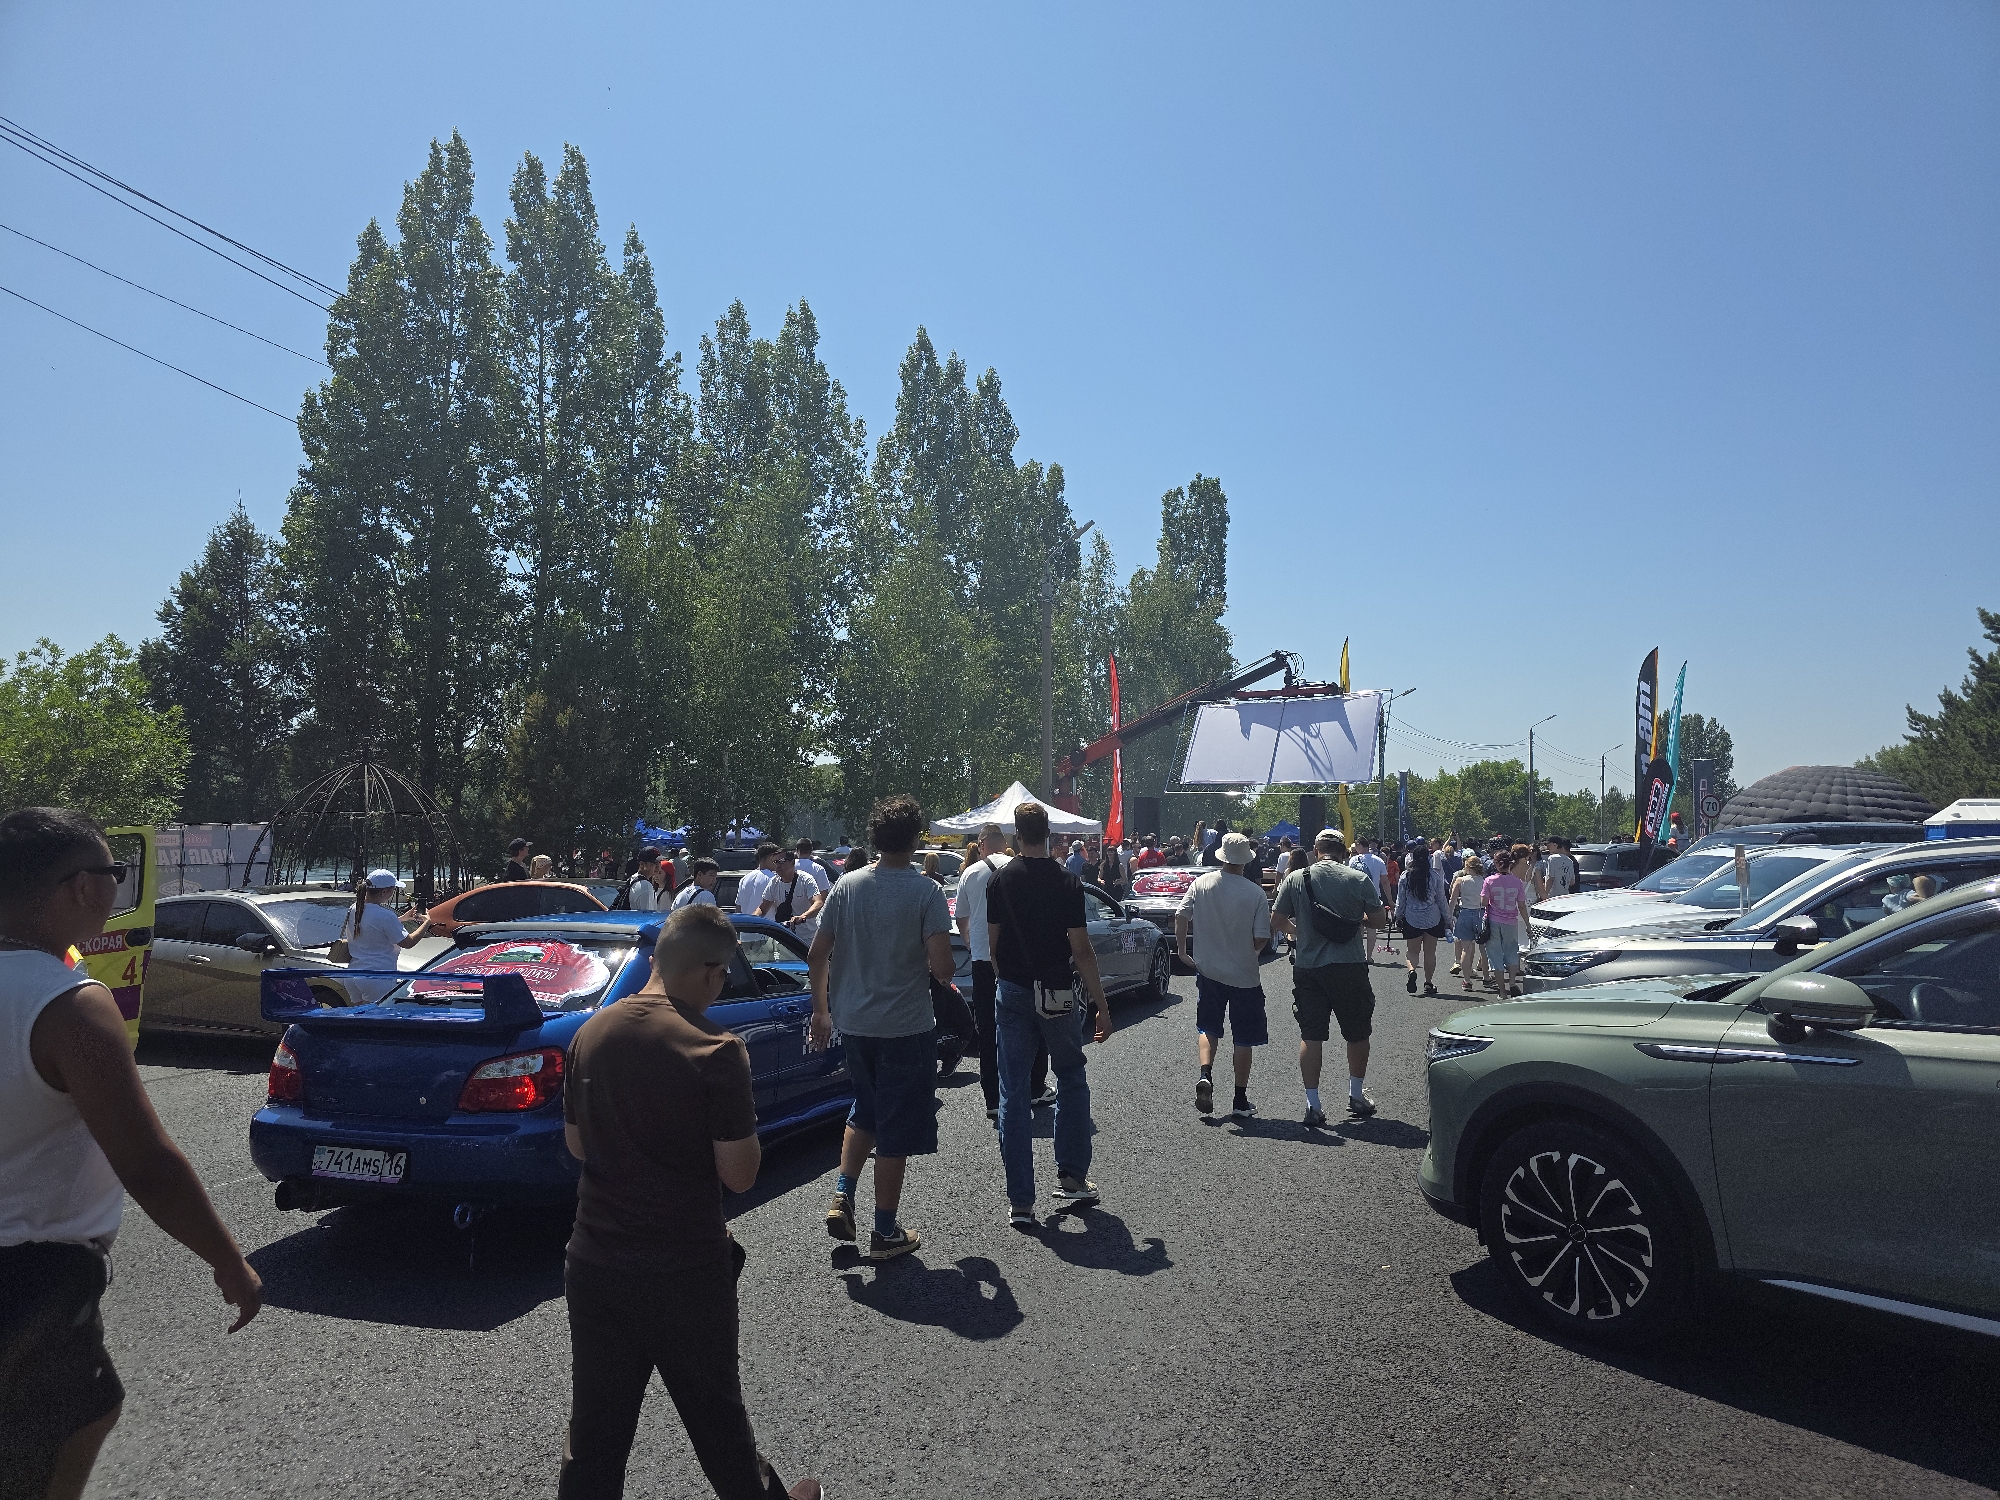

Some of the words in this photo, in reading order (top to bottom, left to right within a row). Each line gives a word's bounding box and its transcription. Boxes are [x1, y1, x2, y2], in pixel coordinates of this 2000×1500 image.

[1705, 801, 1718, 812] 70
[1490, 886, 1519, 911] 33
[77, 934, 123, 953] СКОРАЯ
[122, 955, 138, 986] 4
